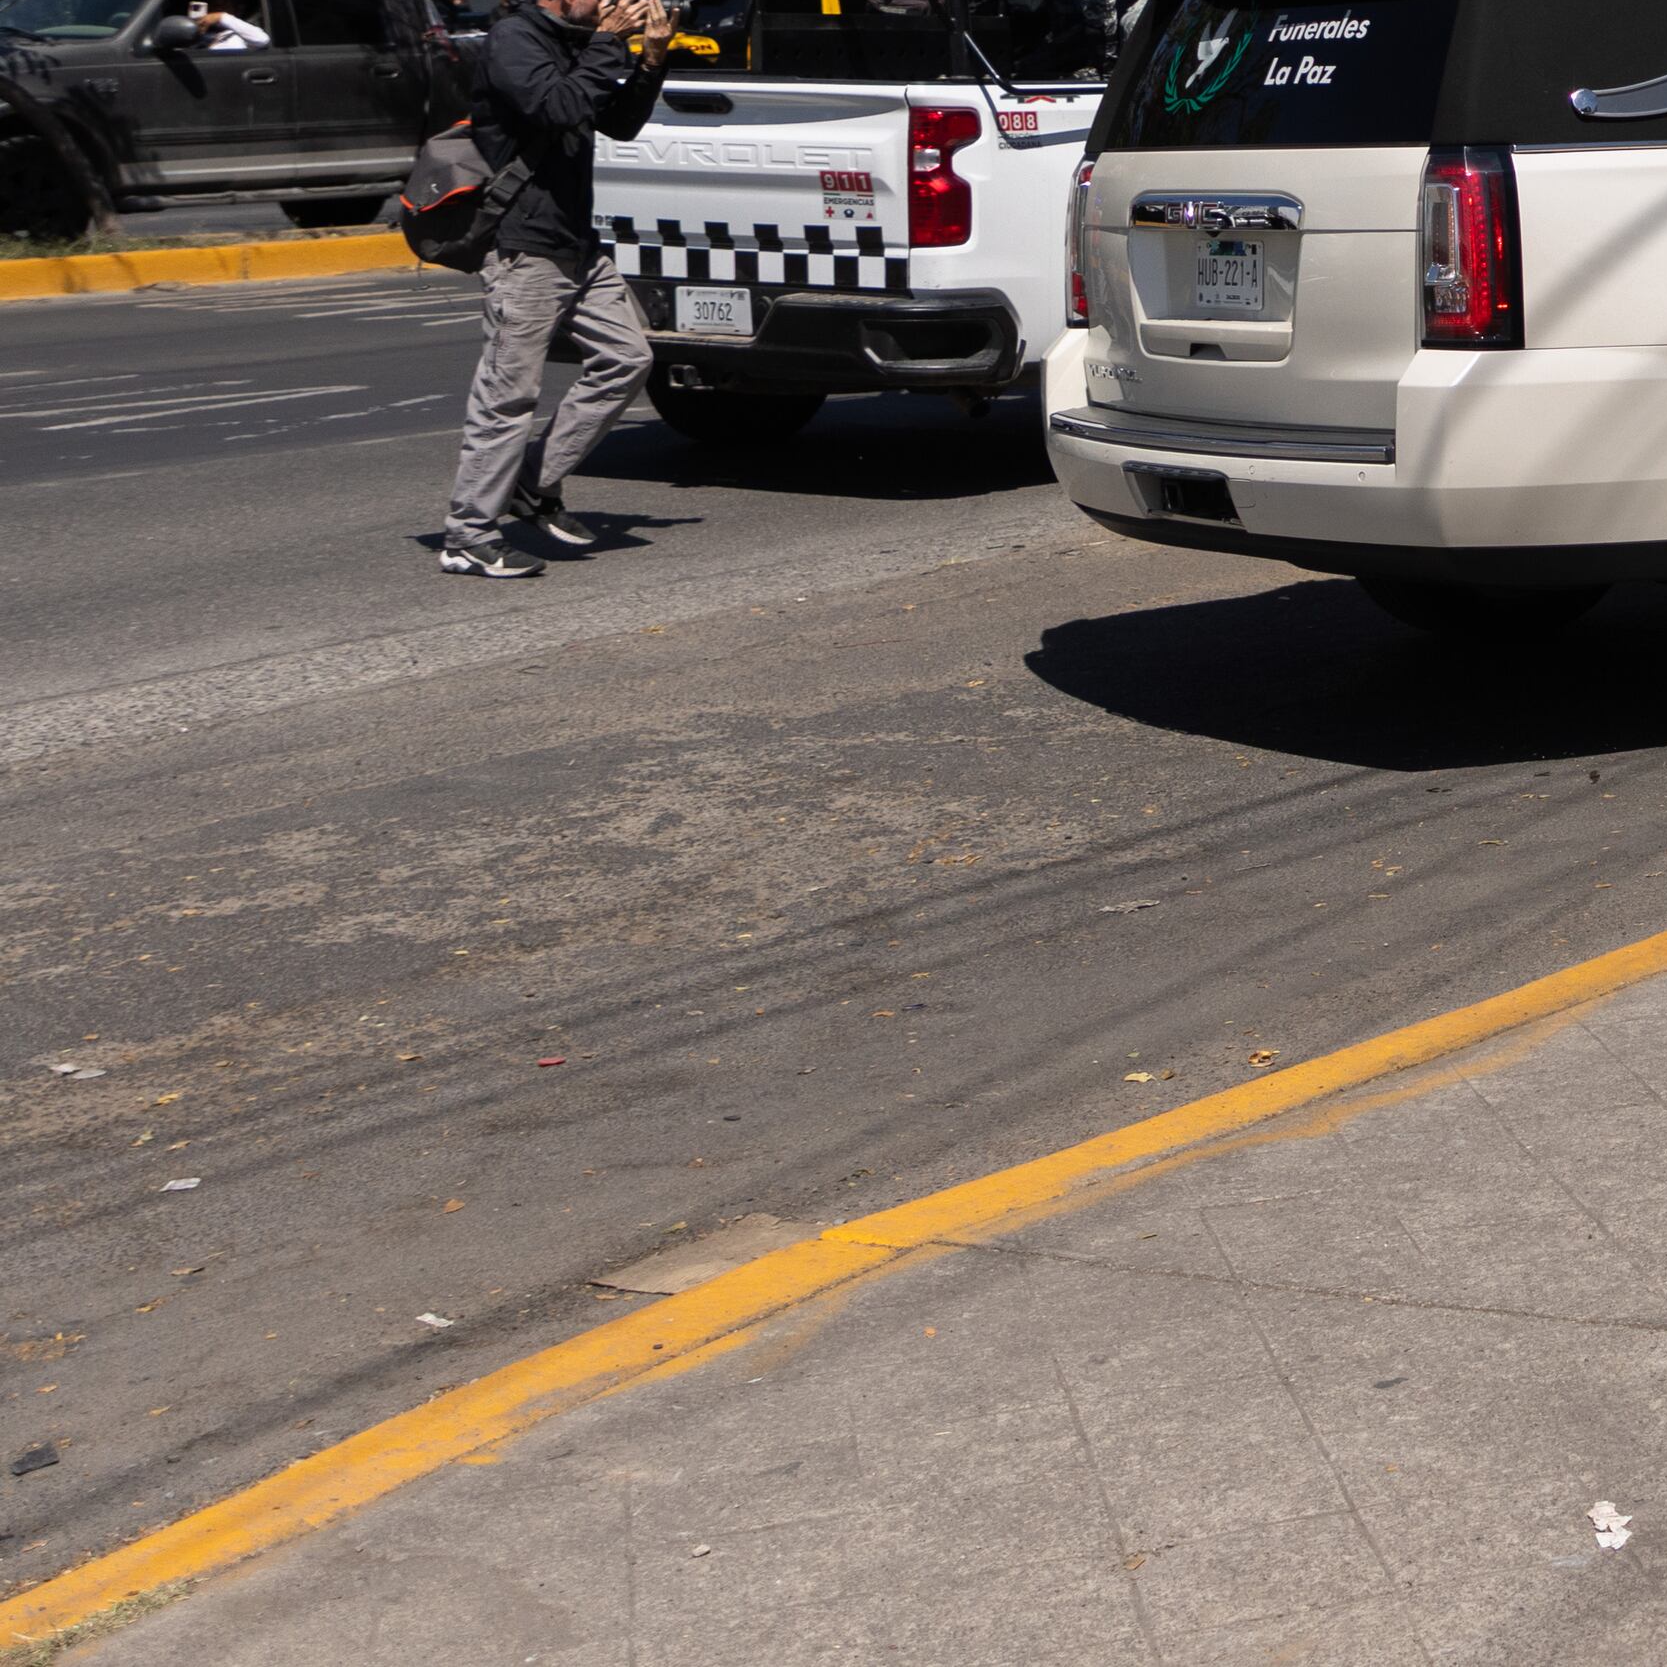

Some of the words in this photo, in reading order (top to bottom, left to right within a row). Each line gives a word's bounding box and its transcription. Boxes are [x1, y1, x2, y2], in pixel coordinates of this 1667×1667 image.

[1268, 9, 1371, 42] Funerales
[1263, 57, 1292, 86] La
[1293, 55, 1337, 85] Paz
[823, 174, 868, 190] 911
[823, 197, 874, 206] EMERGENCIAS
[1164, 202, 1221, 228] GMC
[1197, 258, 1258, 288] HUB-221-A
[694, 301, 733, 321] 30762
